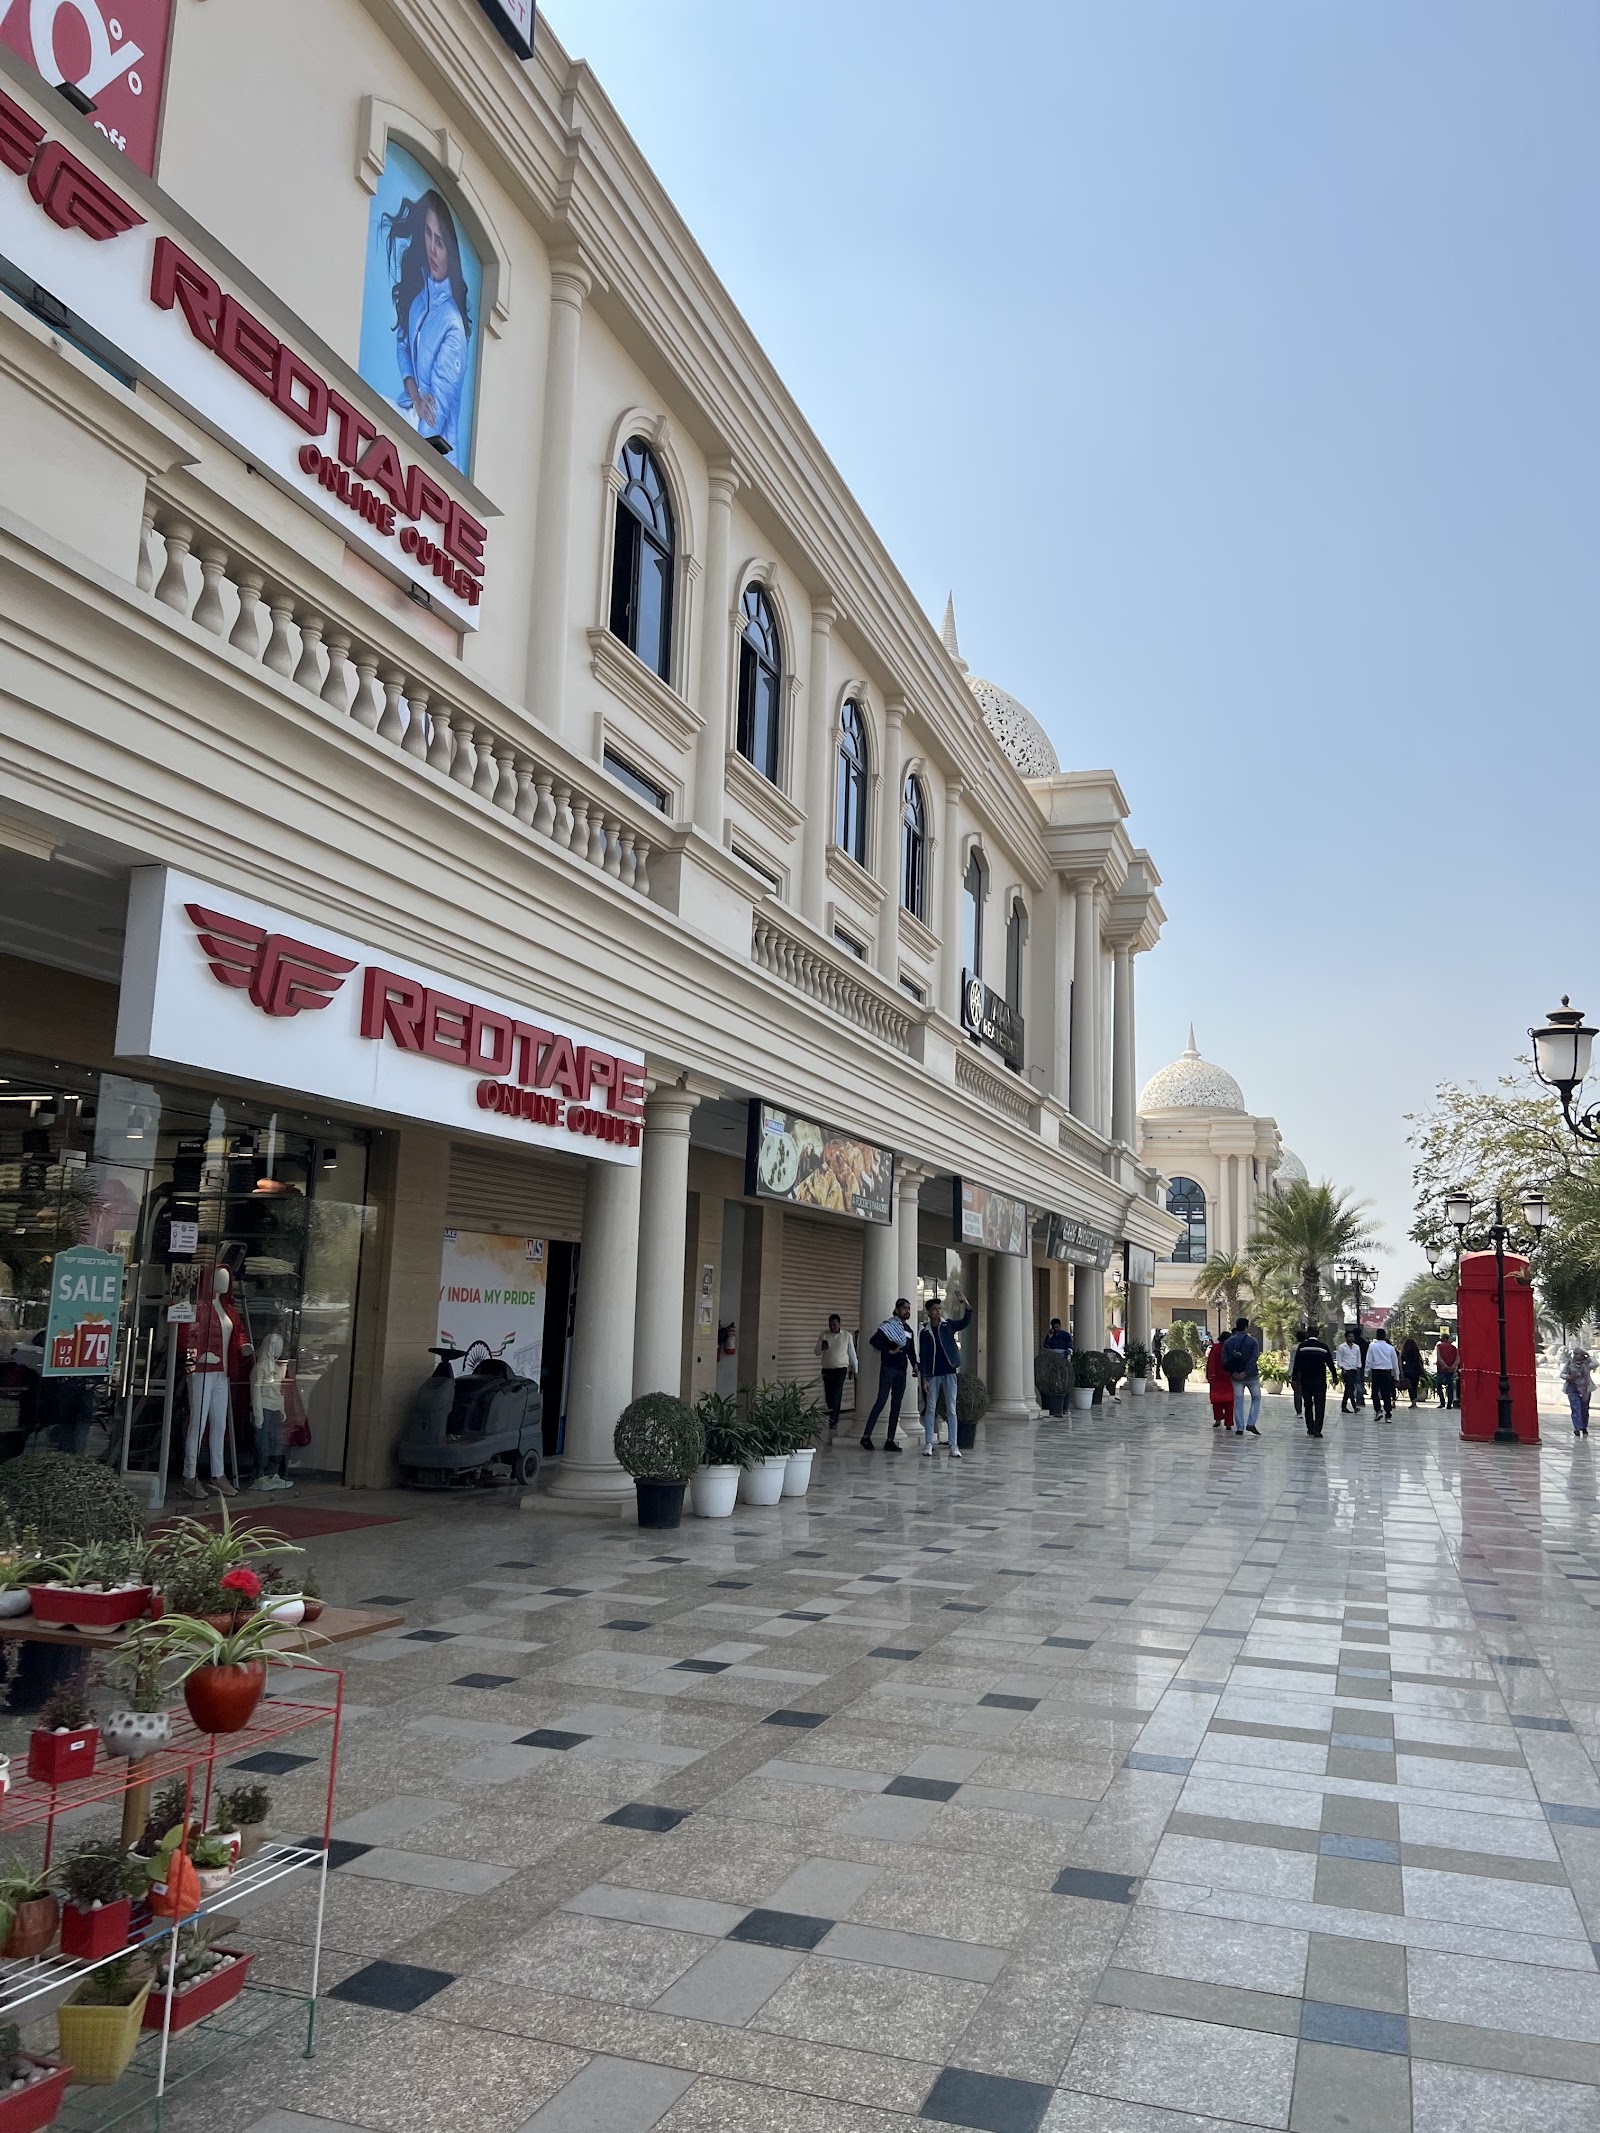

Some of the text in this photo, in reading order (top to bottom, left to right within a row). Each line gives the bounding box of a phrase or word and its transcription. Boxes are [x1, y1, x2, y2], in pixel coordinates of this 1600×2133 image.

[151, 236, 488, 576] REDTAPE
[299, 444, 483, 606] ONLINE OUTLET
[360, 966, 647, 1117] REDTAPE
[476, 1079, 646, 1148] ONLINE OUTLET
[77, 1257, 119, 1266] REDTAPE
[58, 1274, 117, 1303] SALE
[448, 1286, 481, 1303] INDIA
[484, 1289, 502, 1304] MY
[503, 1290, 536, 1306] PRIDE
[58, 1356, 72, 1366] TO
[59, 1345, 73, 1355] UP
[84, 1333, 110, 1361] 70
